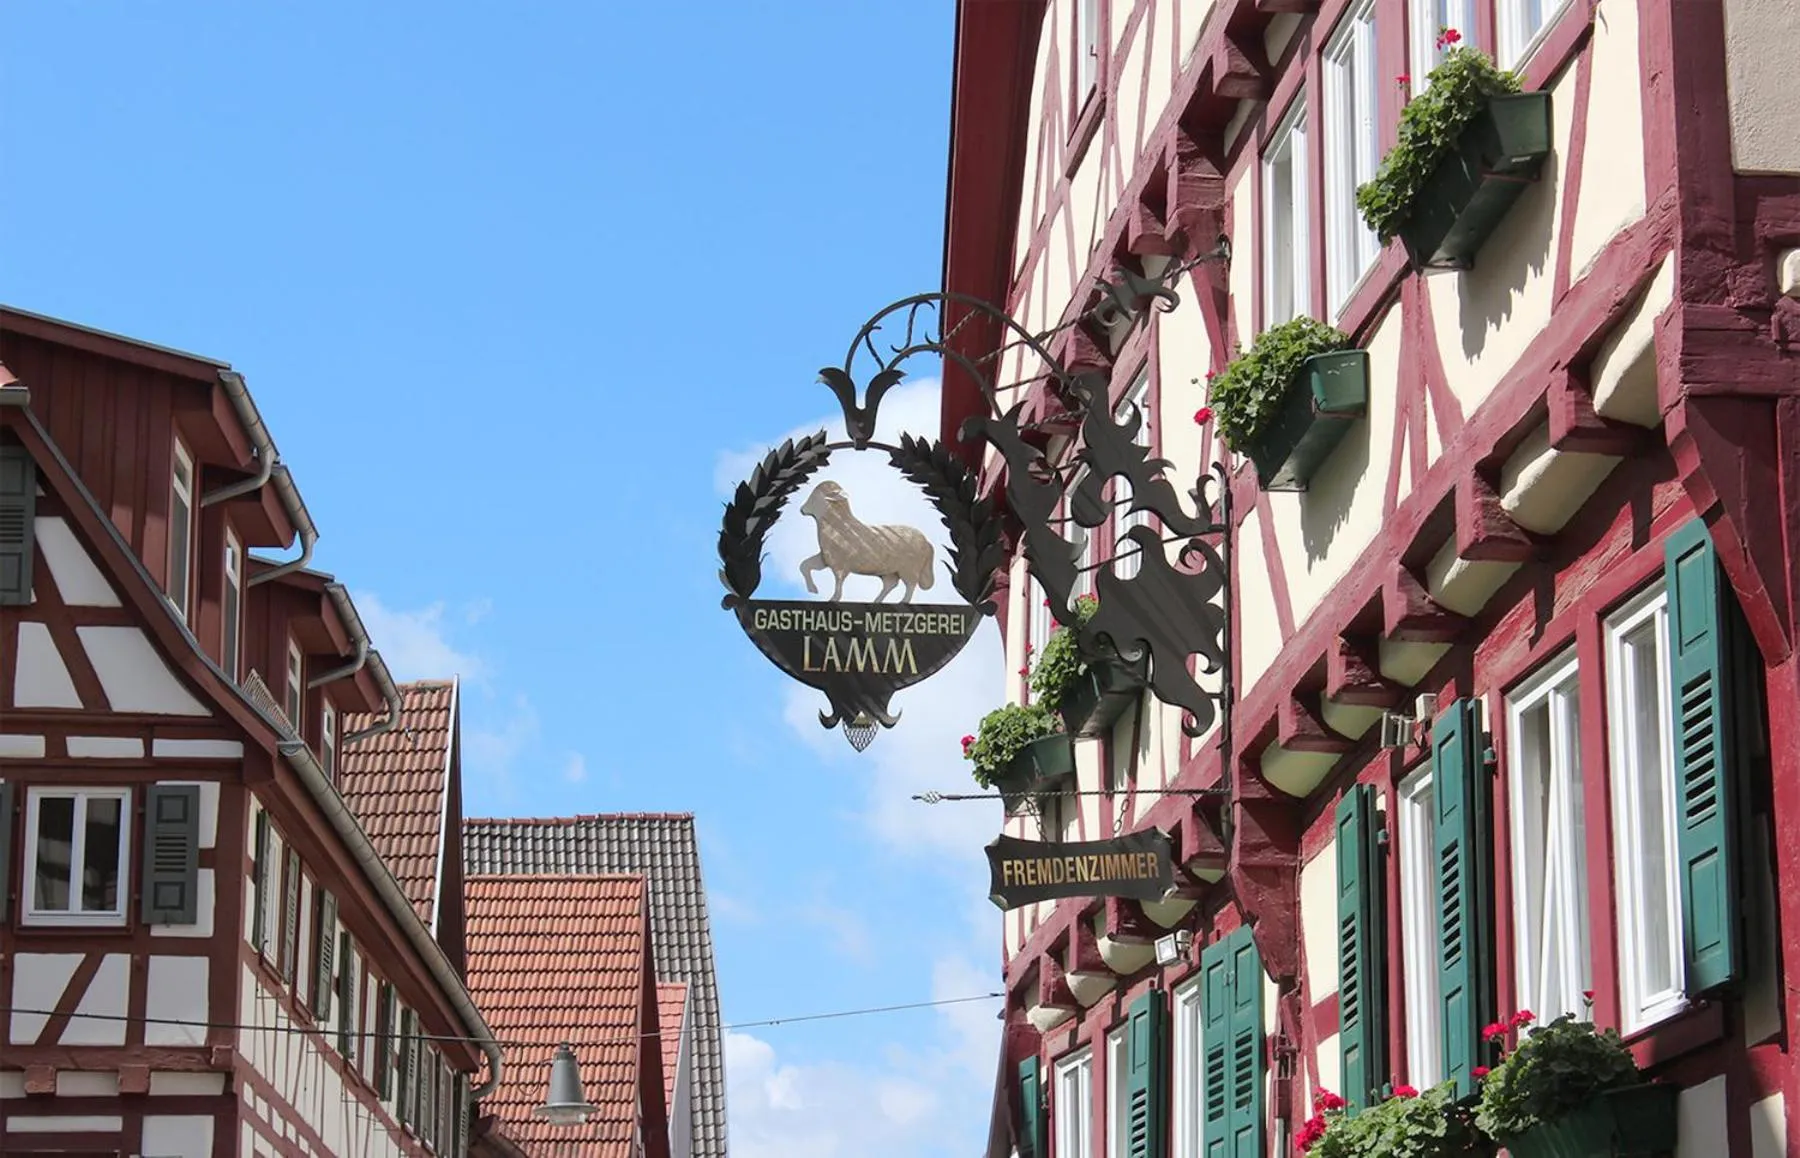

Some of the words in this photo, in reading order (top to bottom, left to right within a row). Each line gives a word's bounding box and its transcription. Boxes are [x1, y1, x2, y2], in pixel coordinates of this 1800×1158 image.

[754, 608, 965, 635] GASTHAUS-METZGEREI
[803, 636, 918, 674] LAMM
[1002, 852, 1160, 887] FREMDENZIMMER
